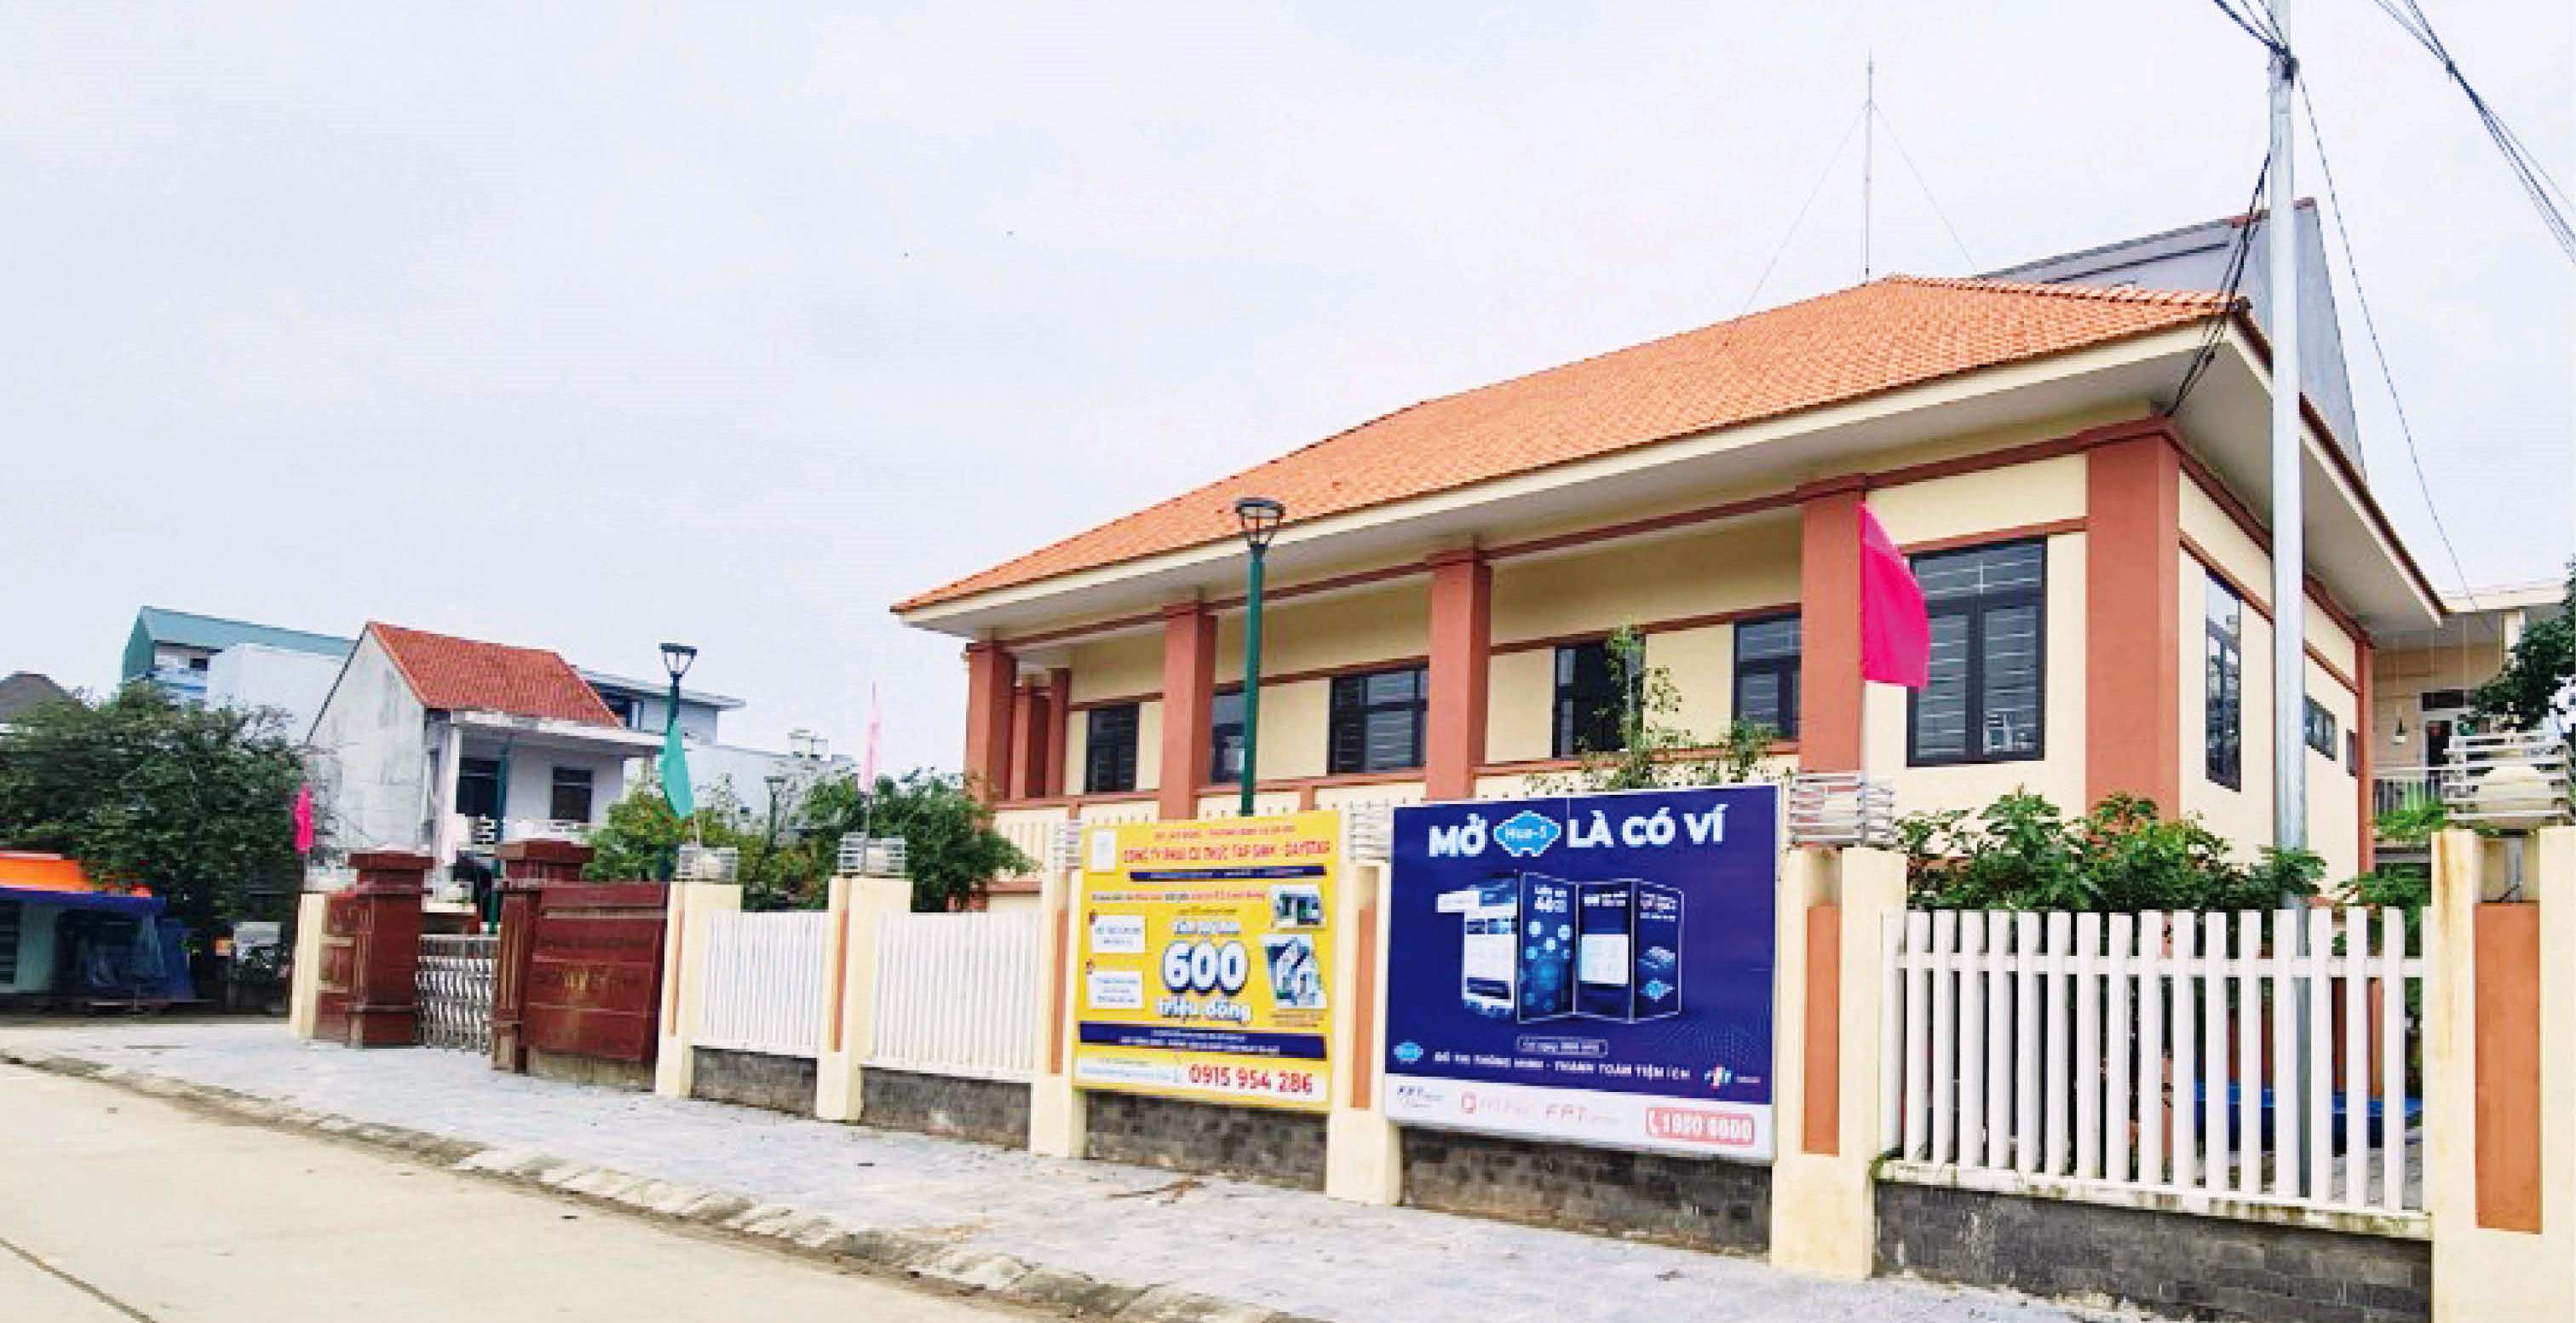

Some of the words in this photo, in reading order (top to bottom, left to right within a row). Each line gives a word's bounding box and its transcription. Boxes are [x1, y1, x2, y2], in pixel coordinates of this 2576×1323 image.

[1429, 813, 1487, 857] MỞ
[1567, 810, 1613, 848] LÀ
[1623, 808, 1676, 846] CÓ
[1684, 804, 1728, 843] VÍ
[1162, 940, 1250, 995] 600
[1189, 1063, 1231, 1086] 0915
[1236, 1067, 1272, 1090] 954
[1279, 1070, 1313, 1096] 286
